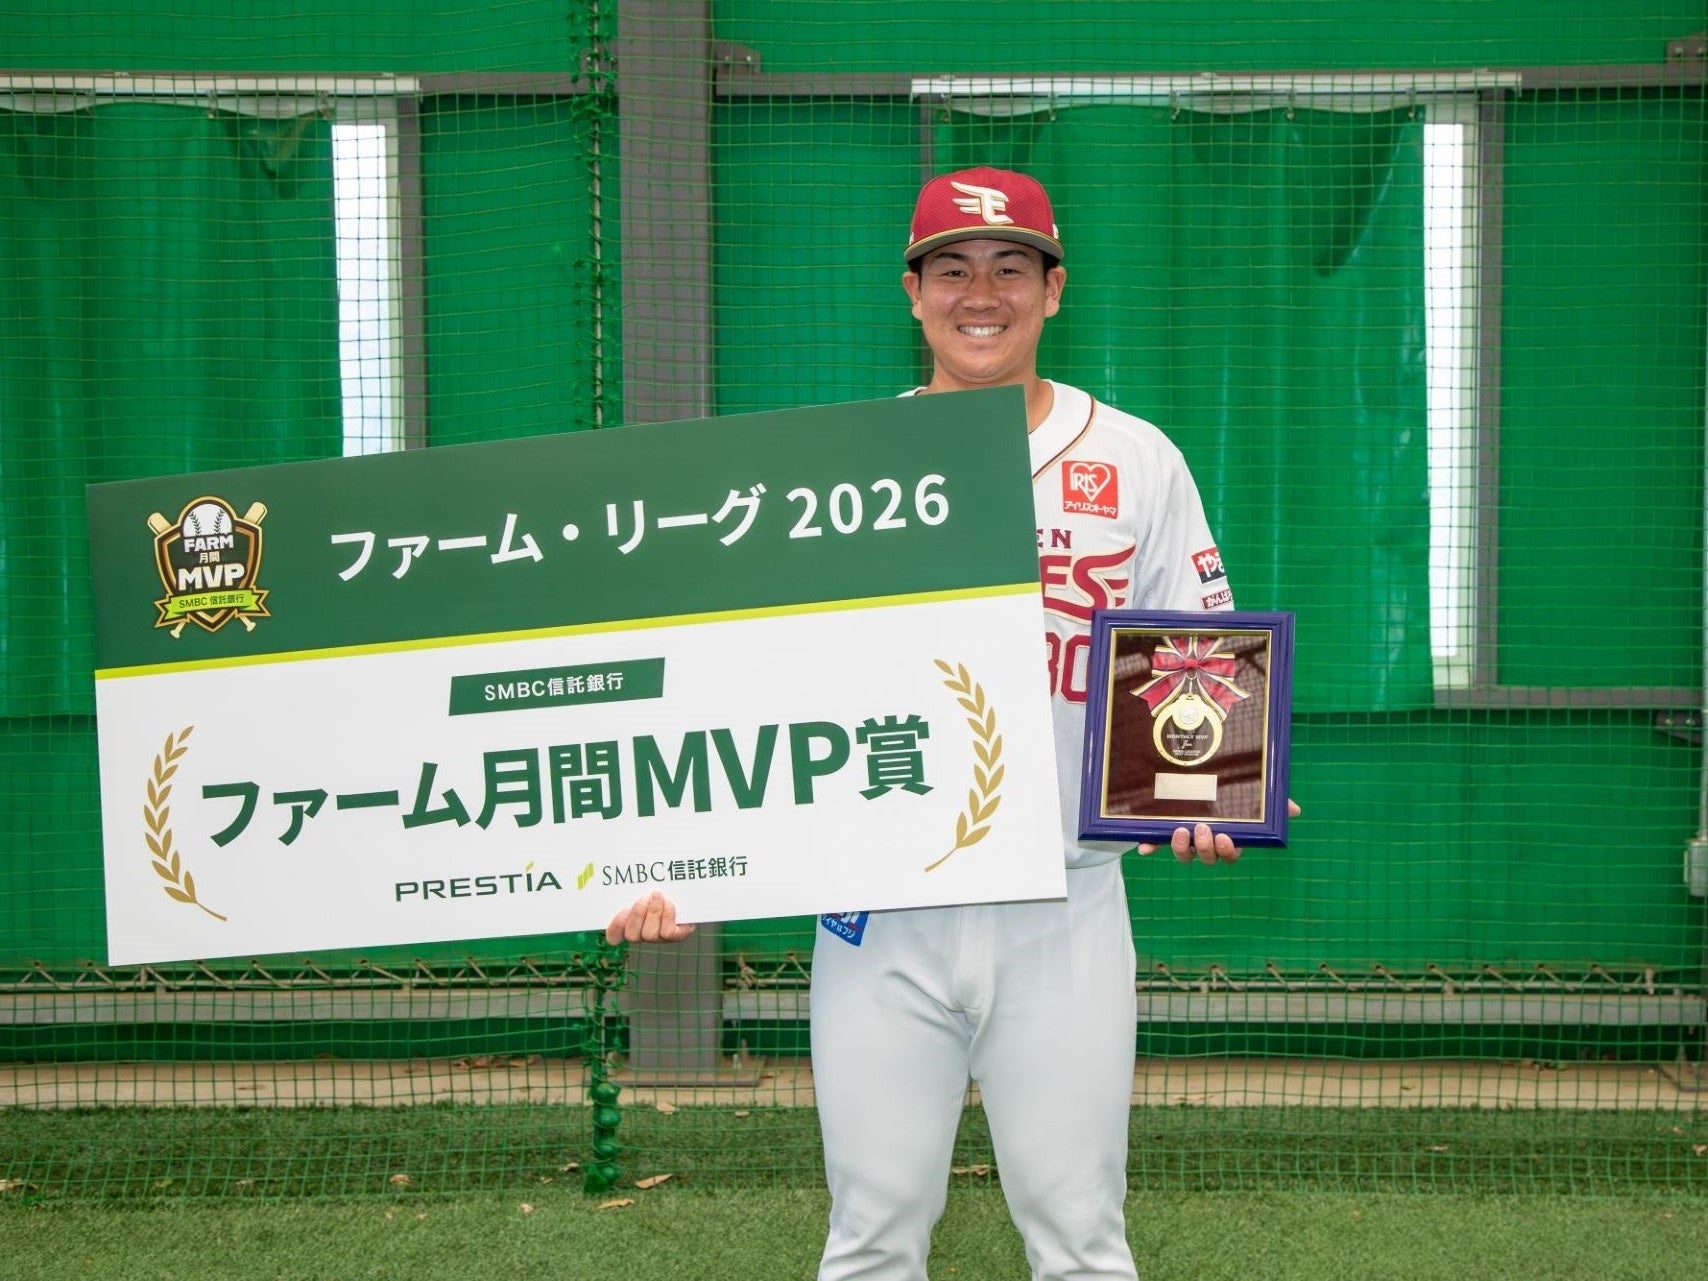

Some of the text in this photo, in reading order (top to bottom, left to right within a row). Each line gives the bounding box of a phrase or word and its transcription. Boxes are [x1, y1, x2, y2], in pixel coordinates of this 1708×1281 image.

[1070, 472, 1098, 493] IRIS
[1063, 500, 1117, 516] アイリスオーヤマ
[330, 473, 949, 582] ファーム・リーグ 2026
[184, 534, 235, 553] FARM
[199, 551, 221, 563] 月間
[178, 562, 245, 591] MVP
[178, 593, 245, 608] SMBC 信託銀行
[484, 672, 624, 702] SMBC信託銀行
[202, 714, 934, 848] ファーム月間MVP賞
[602, 856, 748, 886] SMBC信託銀行
